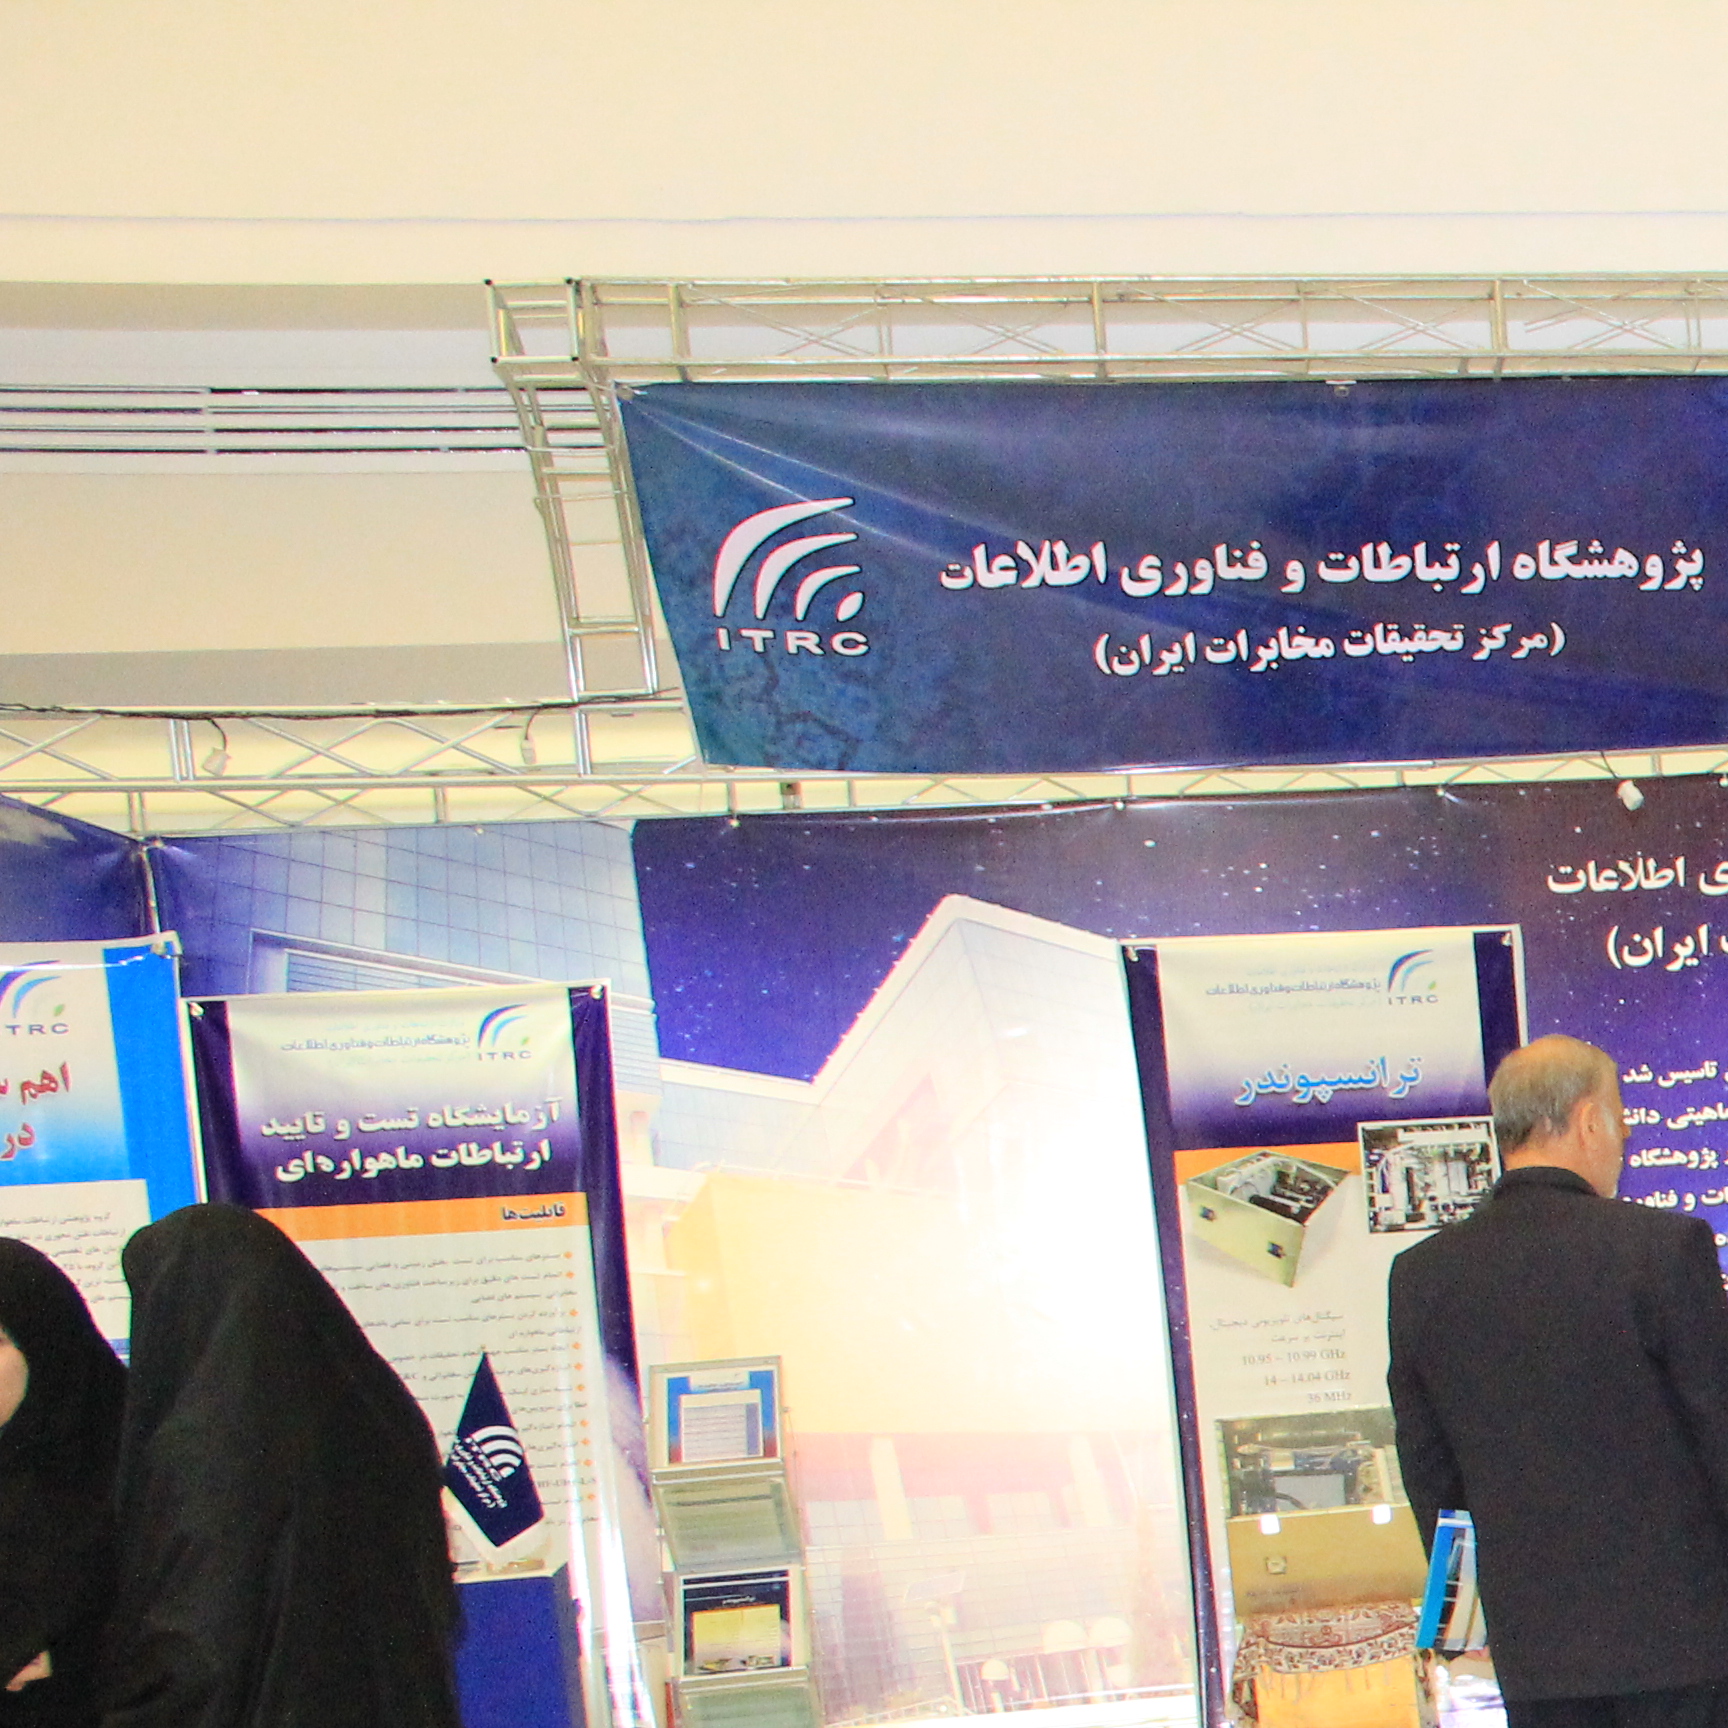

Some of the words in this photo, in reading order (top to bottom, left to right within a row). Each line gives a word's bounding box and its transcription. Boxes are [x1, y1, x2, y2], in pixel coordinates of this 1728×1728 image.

[939, 540, 1109, 591] اطلاعات
[1121, 540, 1269, 598] فناوری
[1281, 557, 1306, 594] و
[1318, 541, 1502, 594] ارتباطات
[1512, 539, 1705, 593] پژوهشگاه
[715, 627, 870, 656] ITRC
[1093, 631, 1197, 676] ایران)
[1203, 625, 1336, 673] مخابرات
[1342, 621, 1466, 663] تحقیقات
[1471, 621, 1566, 661] (مرکز
[1547, 855, 1686, 893] اطلاعات
[1606, 922, 1710, 972] ایران)
[1387, 994, 1439, 1006] ITRC
[4, 1021, 70, 1036] TRC
[478, 1050, 532, 1061] ITRC
[1621, 1063, 1655, 1084] شد
[1657, 1059, 1719, 1088] تاسیس
[20, 1060, 72, 1106] اهم
[1234, 1054, 1424, 1106] ترانسپوندر
[261, 1110, 327, 1141] تایید
[333, 1117, 351, 1140] و
[357, 1106, 420, 1133] تست
[427, 1096, 563, 1131] آزمایشگاه
[429, 1138, 552, 1170] ارتباطات
[1628, 1146, 1721, 1170] پژوهشگاه
[1682, 1191, 1698, 1212] و
